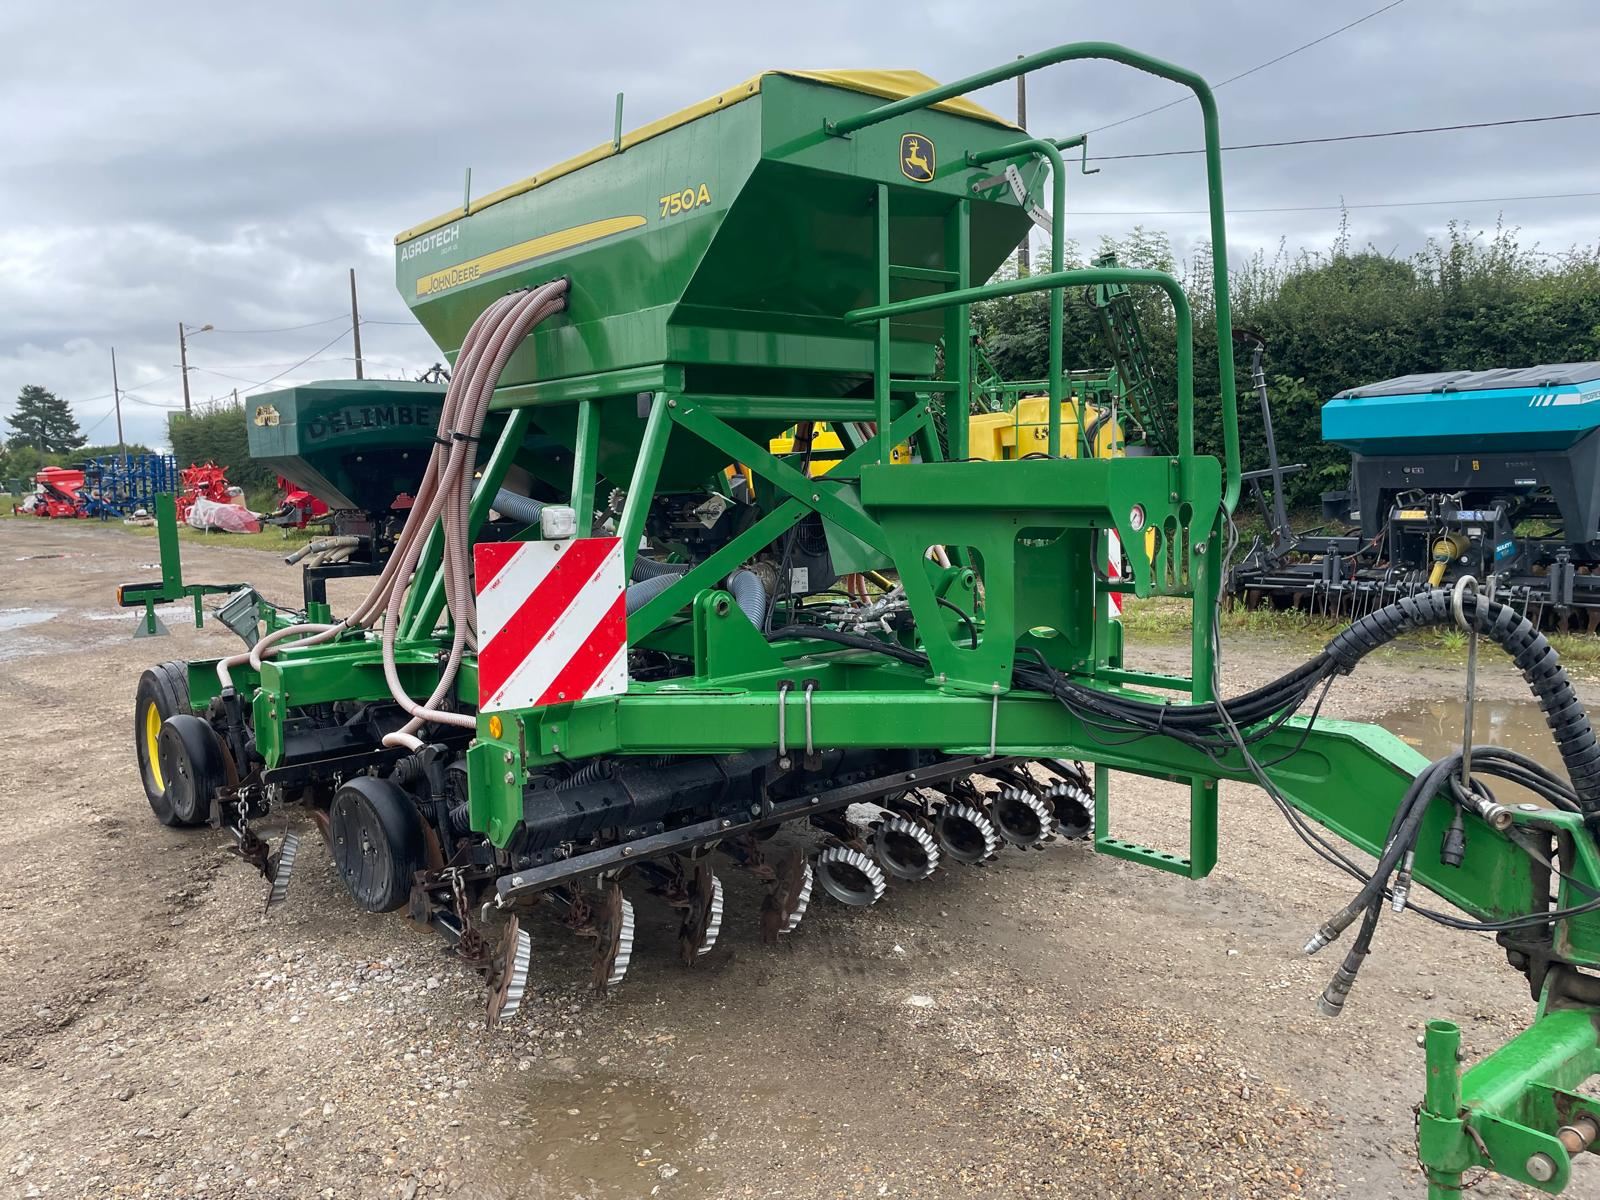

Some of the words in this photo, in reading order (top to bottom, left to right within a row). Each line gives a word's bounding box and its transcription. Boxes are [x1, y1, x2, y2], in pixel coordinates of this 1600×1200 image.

[659, 182, 711, 219] 750A
[401, 224, 460, 262] AGROTECH
[426, 273, 451, 294] JOHN
[451, 264, 480, 284] DEERE
